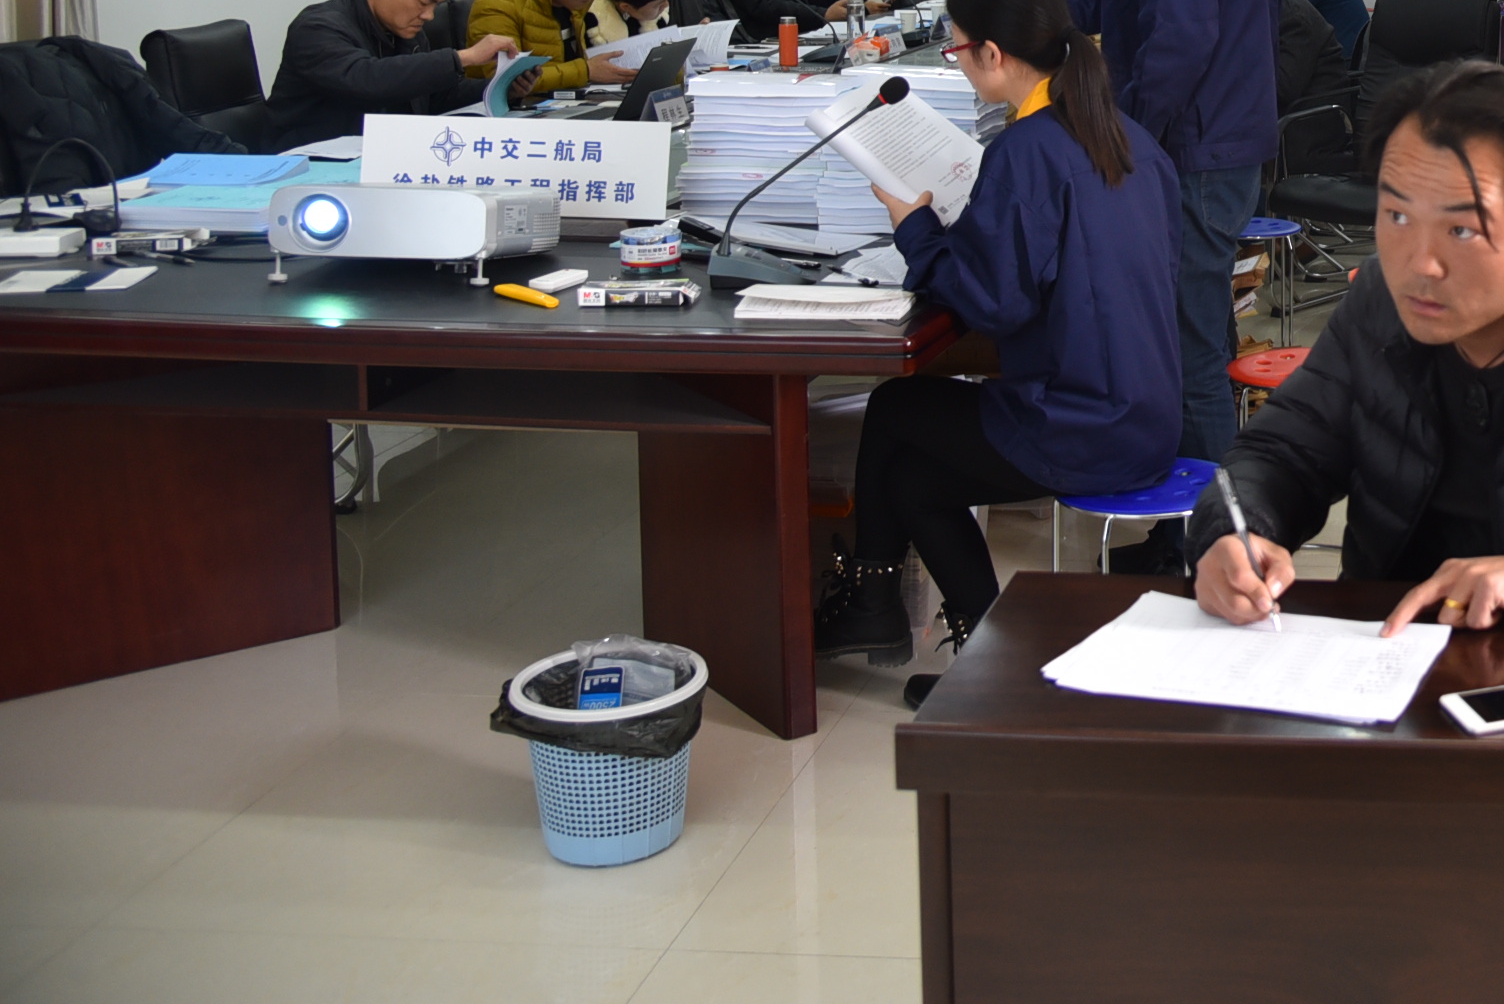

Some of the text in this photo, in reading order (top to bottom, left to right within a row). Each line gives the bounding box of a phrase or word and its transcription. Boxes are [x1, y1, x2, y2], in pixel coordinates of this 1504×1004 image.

[473, 136, 603, 163] 中交二航局
